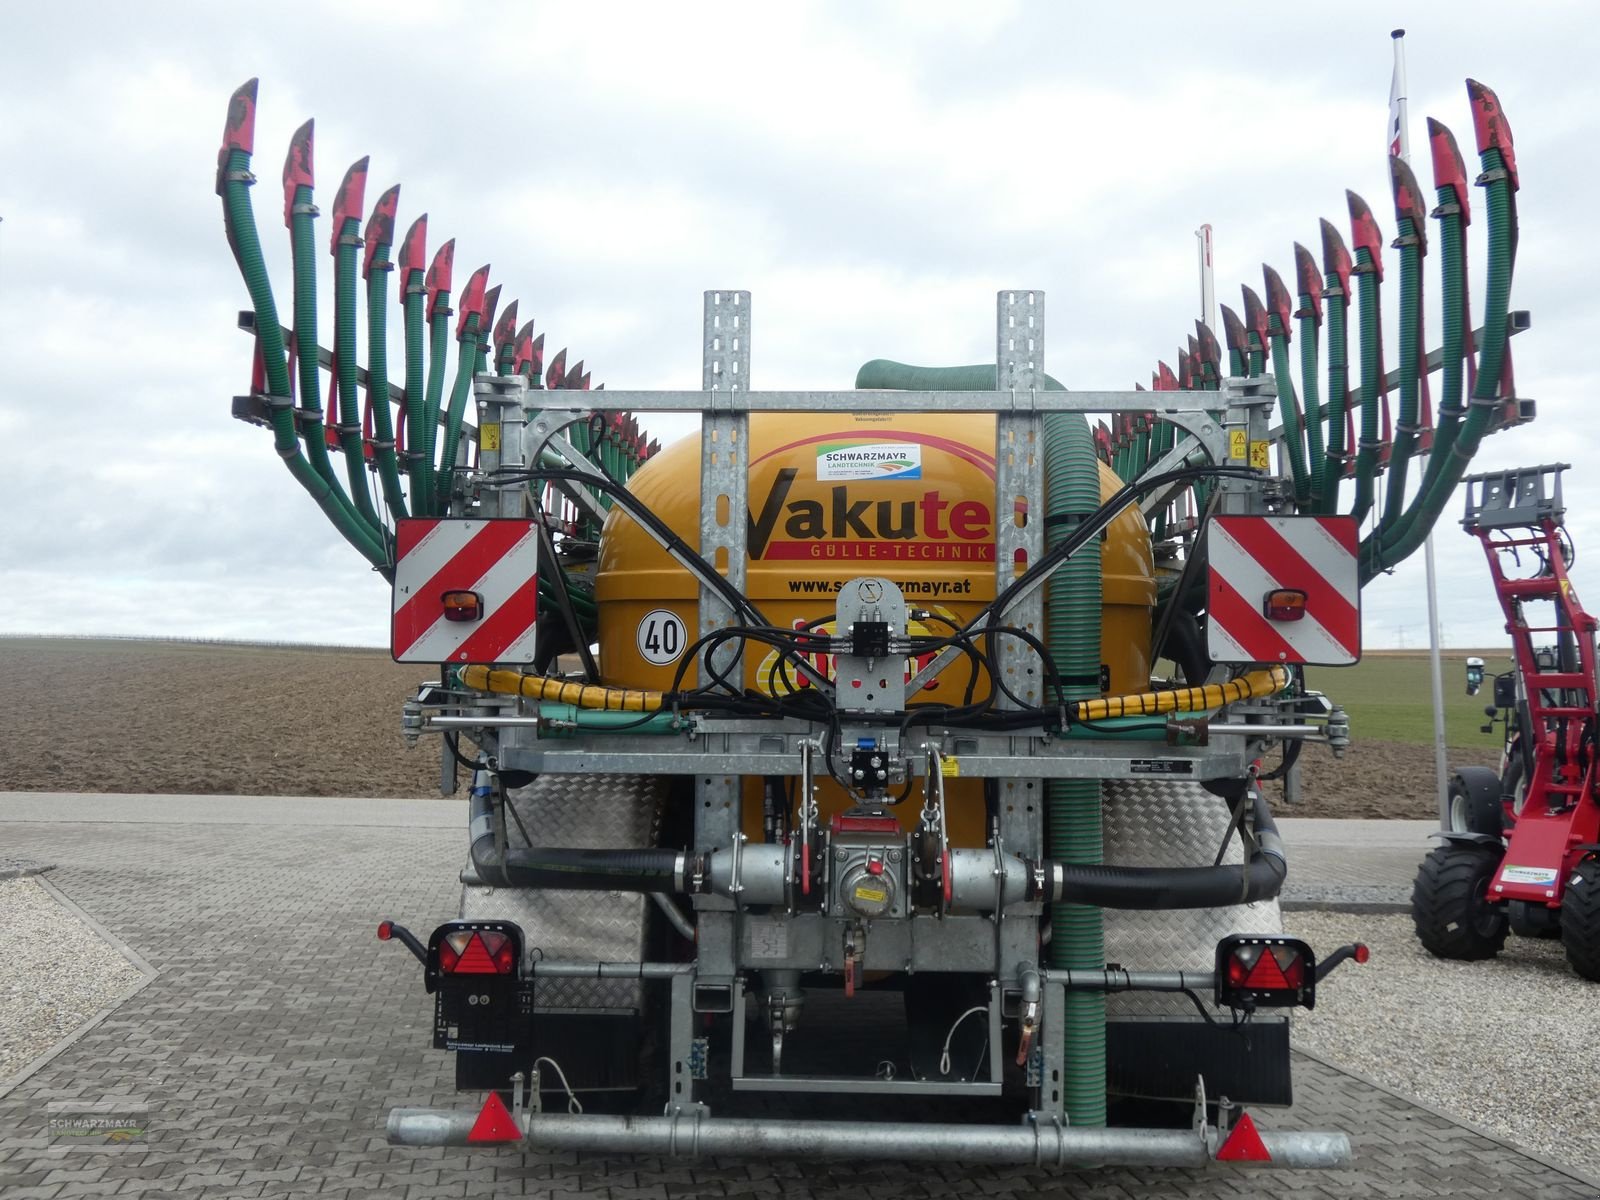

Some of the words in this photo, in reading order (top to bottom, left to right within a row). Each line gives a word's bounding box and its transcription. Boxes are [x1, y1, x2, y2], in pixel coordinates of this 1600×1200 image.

[826, 452, 907, 462] SCHWARZMAYR
[748, 468, 992, 561] Vakute
[810, 543, 988, 559] GÜLLE-TECHNIK
[789, 578, 971, 597] www.szmayr.at
[645, 620, 677, 654] 40
